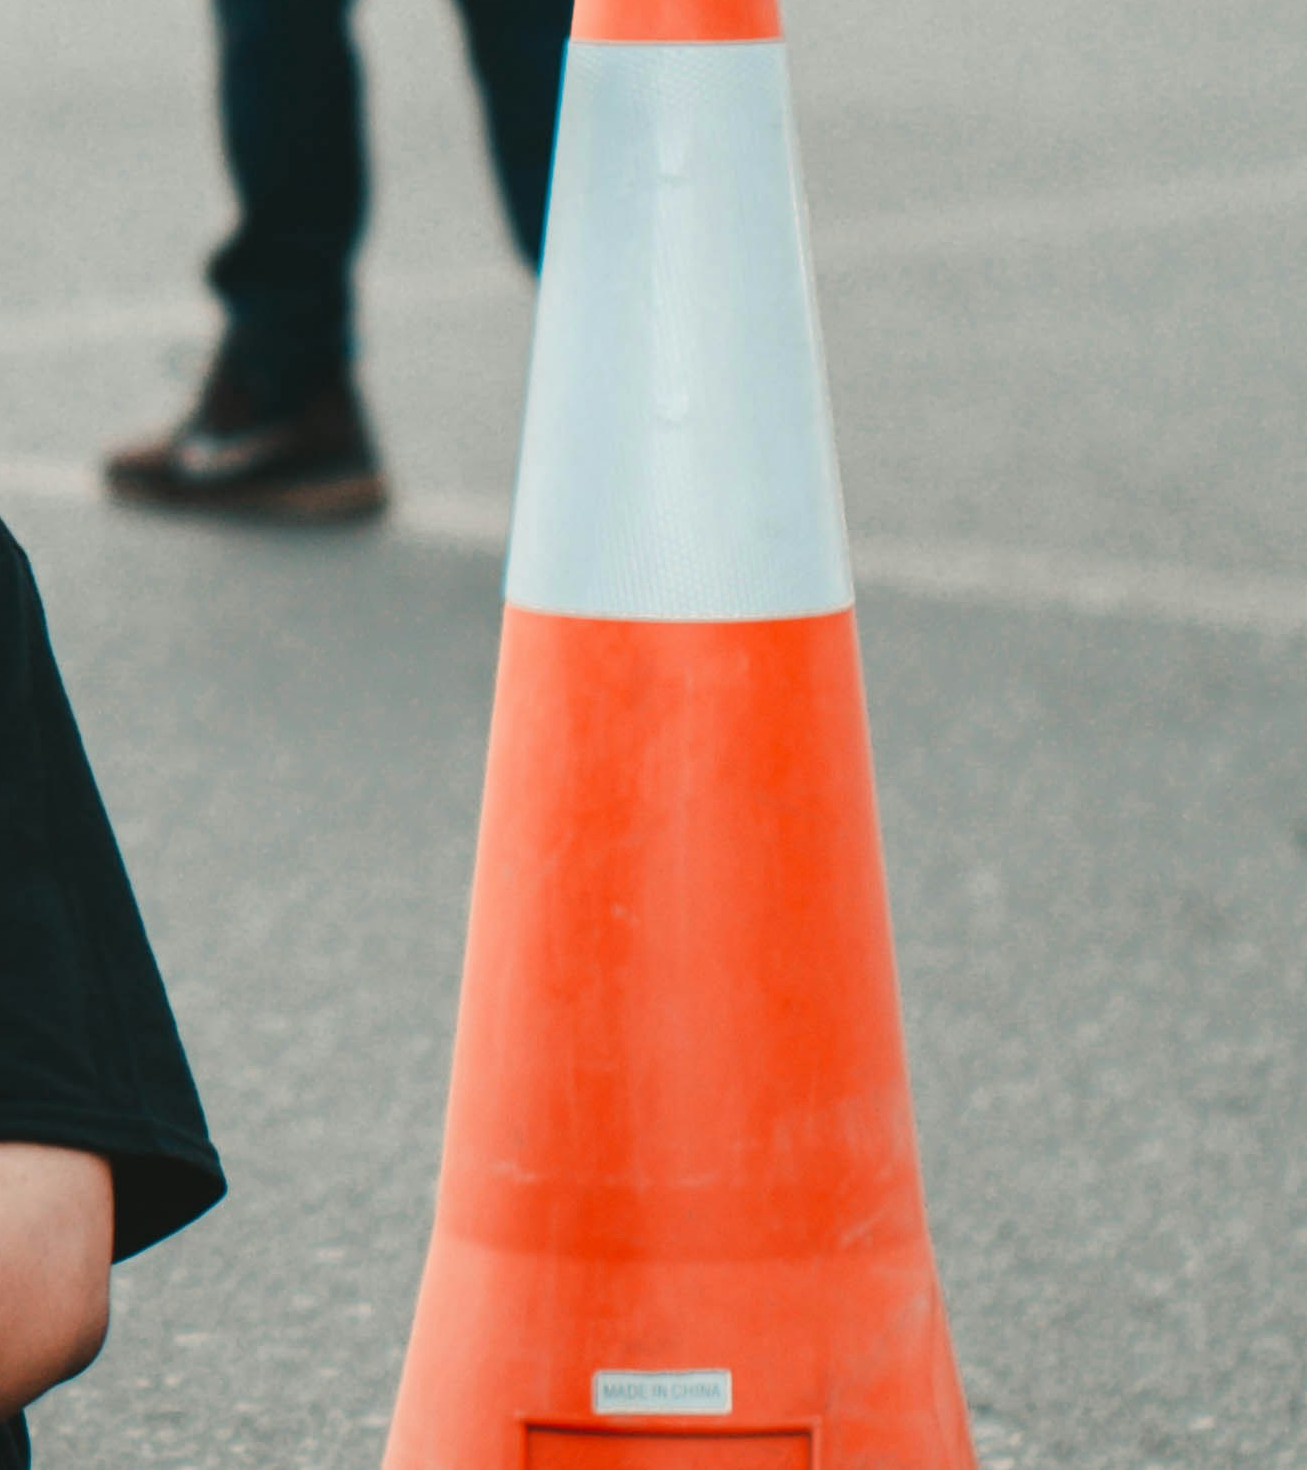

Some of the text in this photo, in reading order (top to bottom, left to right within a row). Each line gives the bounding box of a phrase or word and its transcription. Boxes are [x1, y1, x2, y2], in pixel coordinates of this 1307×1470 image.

[603, 1383, 721, 1400] MADE IN CHINA
